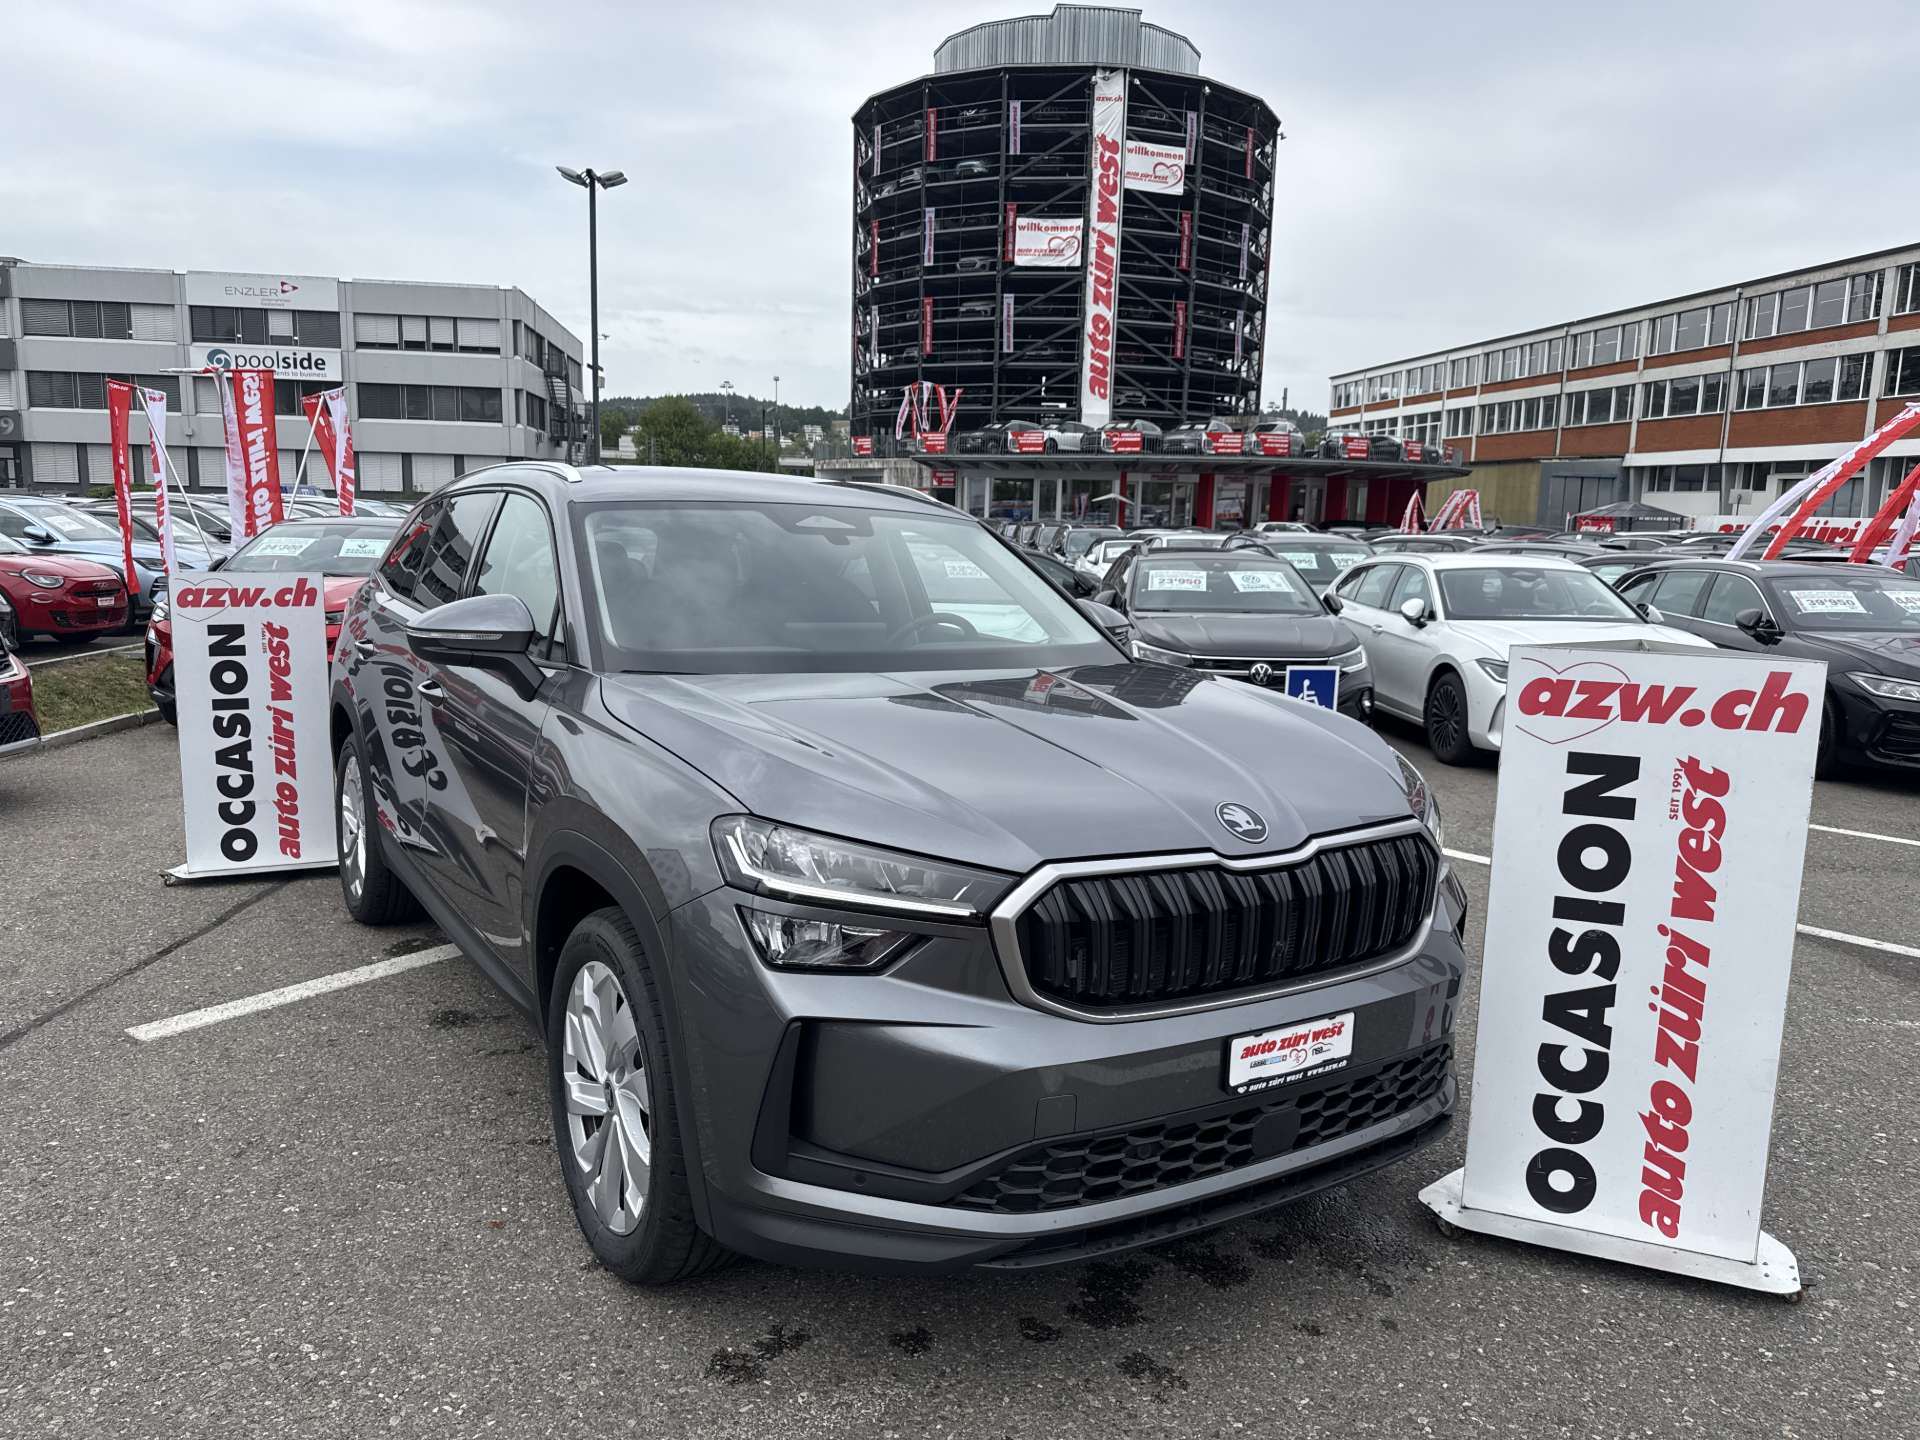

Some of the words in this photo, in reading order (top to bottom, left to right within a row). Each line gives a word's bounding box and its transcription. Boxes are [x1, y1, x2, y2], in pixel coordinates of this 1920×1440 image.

[1096, 133, 1120, 223] west
[1126, 145, 1184, 161] willkommen
[1018, 222, 1081, 233] willkommen
[224, 286, 278, 297] ENZLER
[1088, 227, 1116, 312] züri
[234, 351, 326, 371] poolside
[1088, 313, 1112, 400] auto
[176, 577, 317, 608] azw.ch
[262, 620, 293, 701] west
[1518, 672, 1809, 734] azw.ch
[207, 623, 258, 862] OCCASION
[266, 705, 297, 780] züri
[1669, 797, 1680, 820] SEIT
[1671, 768, 1683, 793] 1991
[272, 781, 301, 859] auto
[1672, 754, 1730, 922] west
[1526, 751, 1641, 1213] OCCASION
[1647, 924, 1711, 1085] züri
[1240, 1038, 1277, 1059] auto
[1277, 1029, 1311, 1051] züri
[1311, 1022, 1345, 1042] west
[1248, 1082, 1266, 1092] auto
[1285, 1071, 1304, 1083] west
[1637, 1081, 1694, 1238] auto
